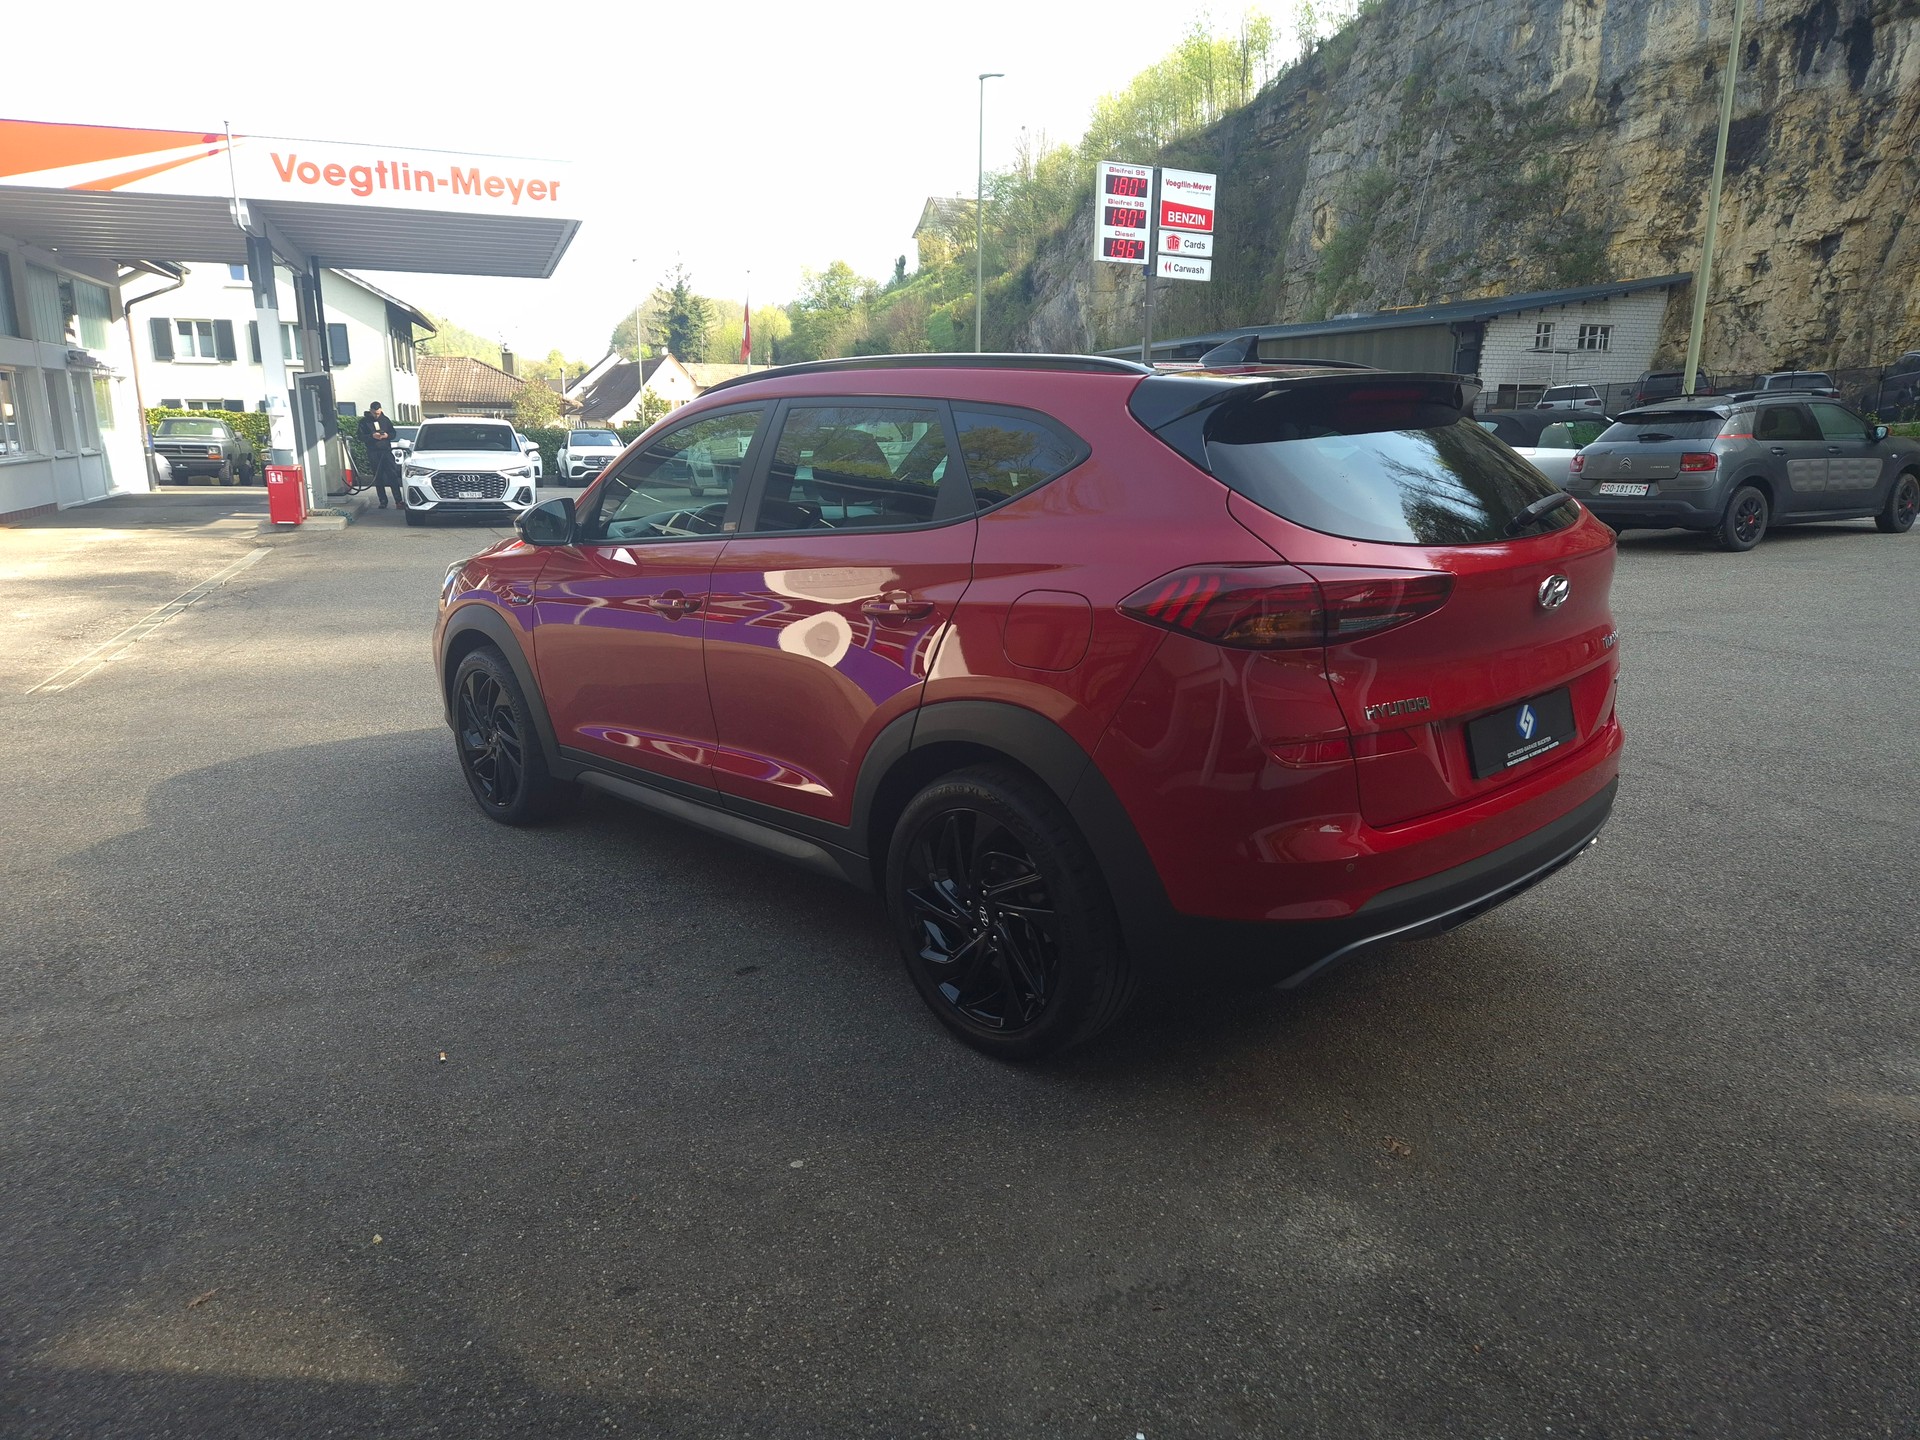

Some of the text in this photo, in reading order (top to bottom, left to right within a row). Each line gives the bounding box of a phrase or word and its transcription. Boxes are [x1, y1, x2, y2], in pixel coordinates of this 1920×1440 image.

[1108, 166, 1133, 175] Bleifrei
[270, 152, 560, 205] Voegtlin-Meyer
[1165, 178, 1212, 191] Voegtlin-Meyer
[1107, 198, 1132, 206] Bleifrei
[1167, 210, 1206, 226] BENZIN
[1114, 230, 1136, 238] Diesel
[1183, 239, 1206, 250] Cards
[1173, 263, 1205, 275] Carwash
[1364, 696, 1430, 721] HYUNDAI
